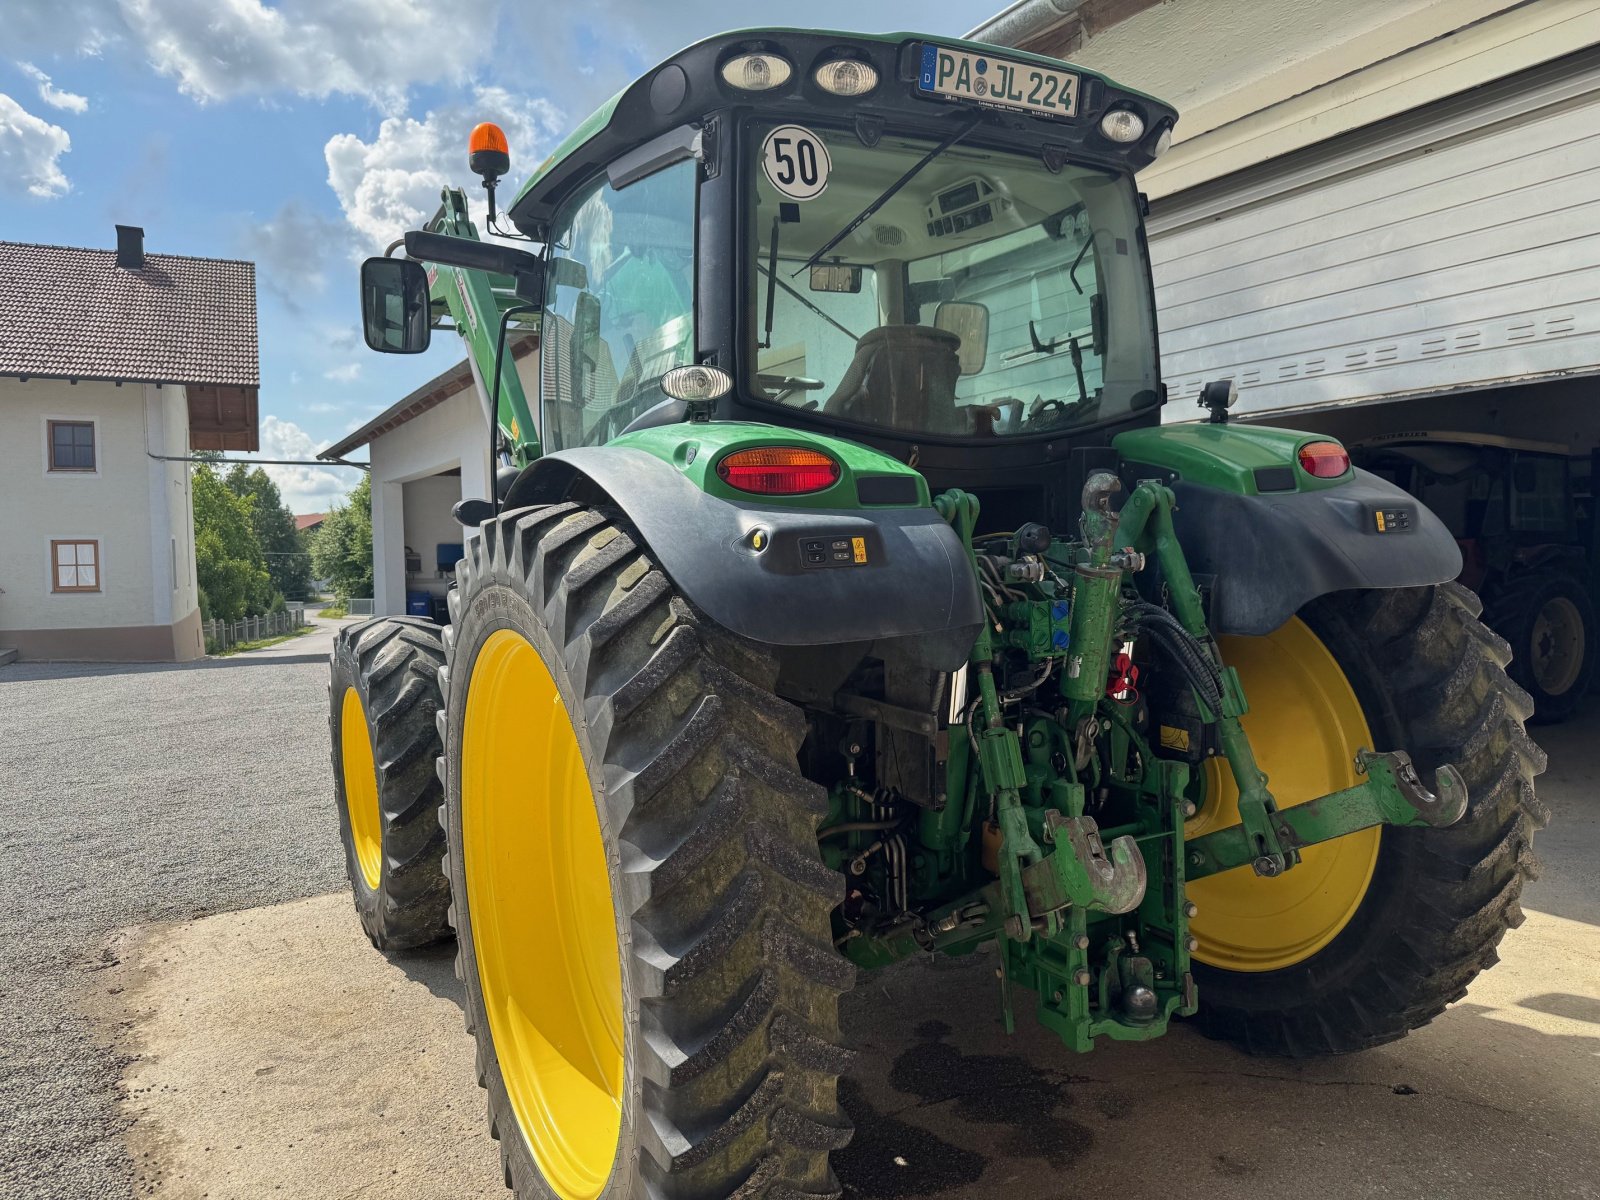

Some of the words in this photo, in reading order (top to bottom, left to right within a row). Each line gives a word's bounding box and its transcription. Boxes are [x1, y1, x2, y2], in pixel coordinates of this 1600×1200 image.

[924, 73, 931, 83] D
[938, 53, 971, 92] PA
[990, 65, 1022, 101] JL
[1027, 71, 1072, 110] 224
[773, 137, 818, 186] 50
